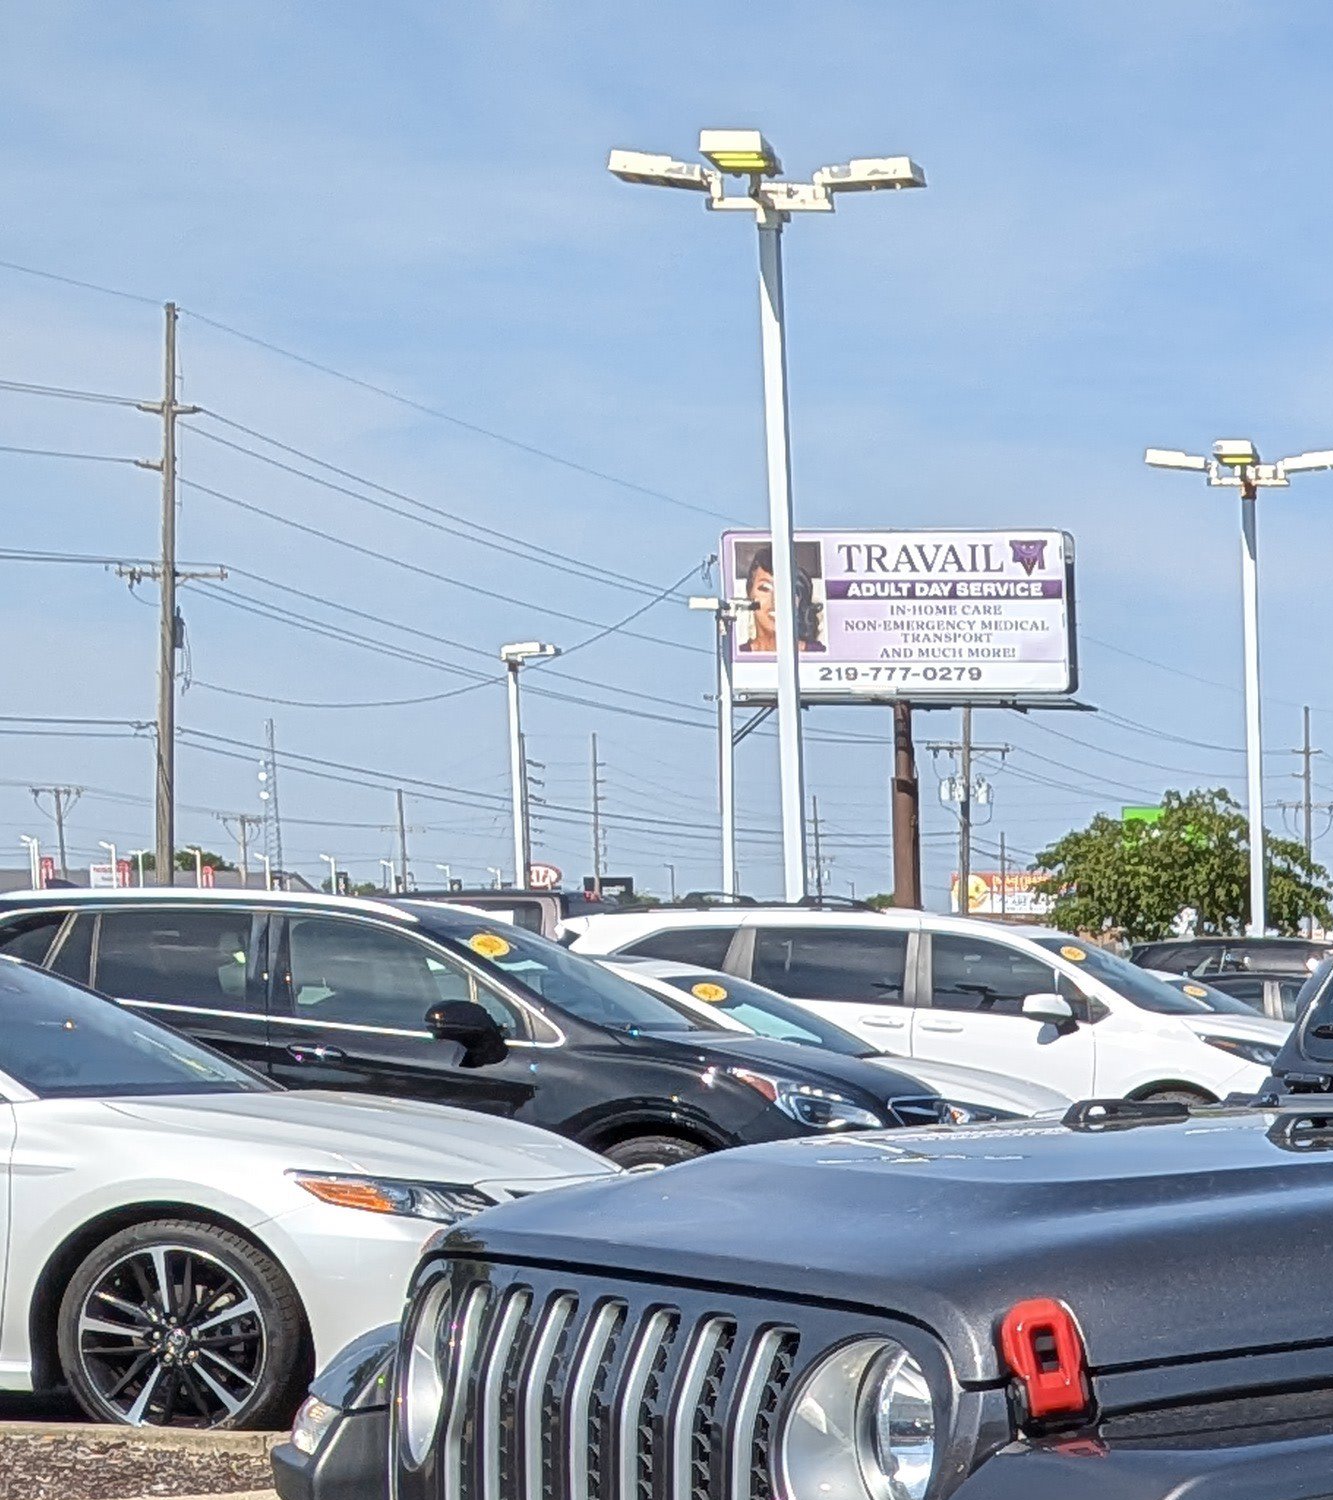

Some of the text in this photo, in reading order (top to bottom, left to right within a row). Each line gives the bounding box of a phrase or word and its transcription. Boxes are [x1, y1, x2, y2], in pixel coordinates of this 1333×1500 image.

[837, 543, 1004, 573] TRAVAIL
[847, 582, 1044, 597] ADULT DAY SERVICE
[890, 604, 1003, 616] IN-HOME CARE
[844, 620, 1050, 631] NON-EMERGENCY MEDICAL
[901, 632, 993, 643] TRANSPORT
[880, 647, 1016, 659] AND MUCH MORE!
[819, 666, 983, 681] 219-777-0279
